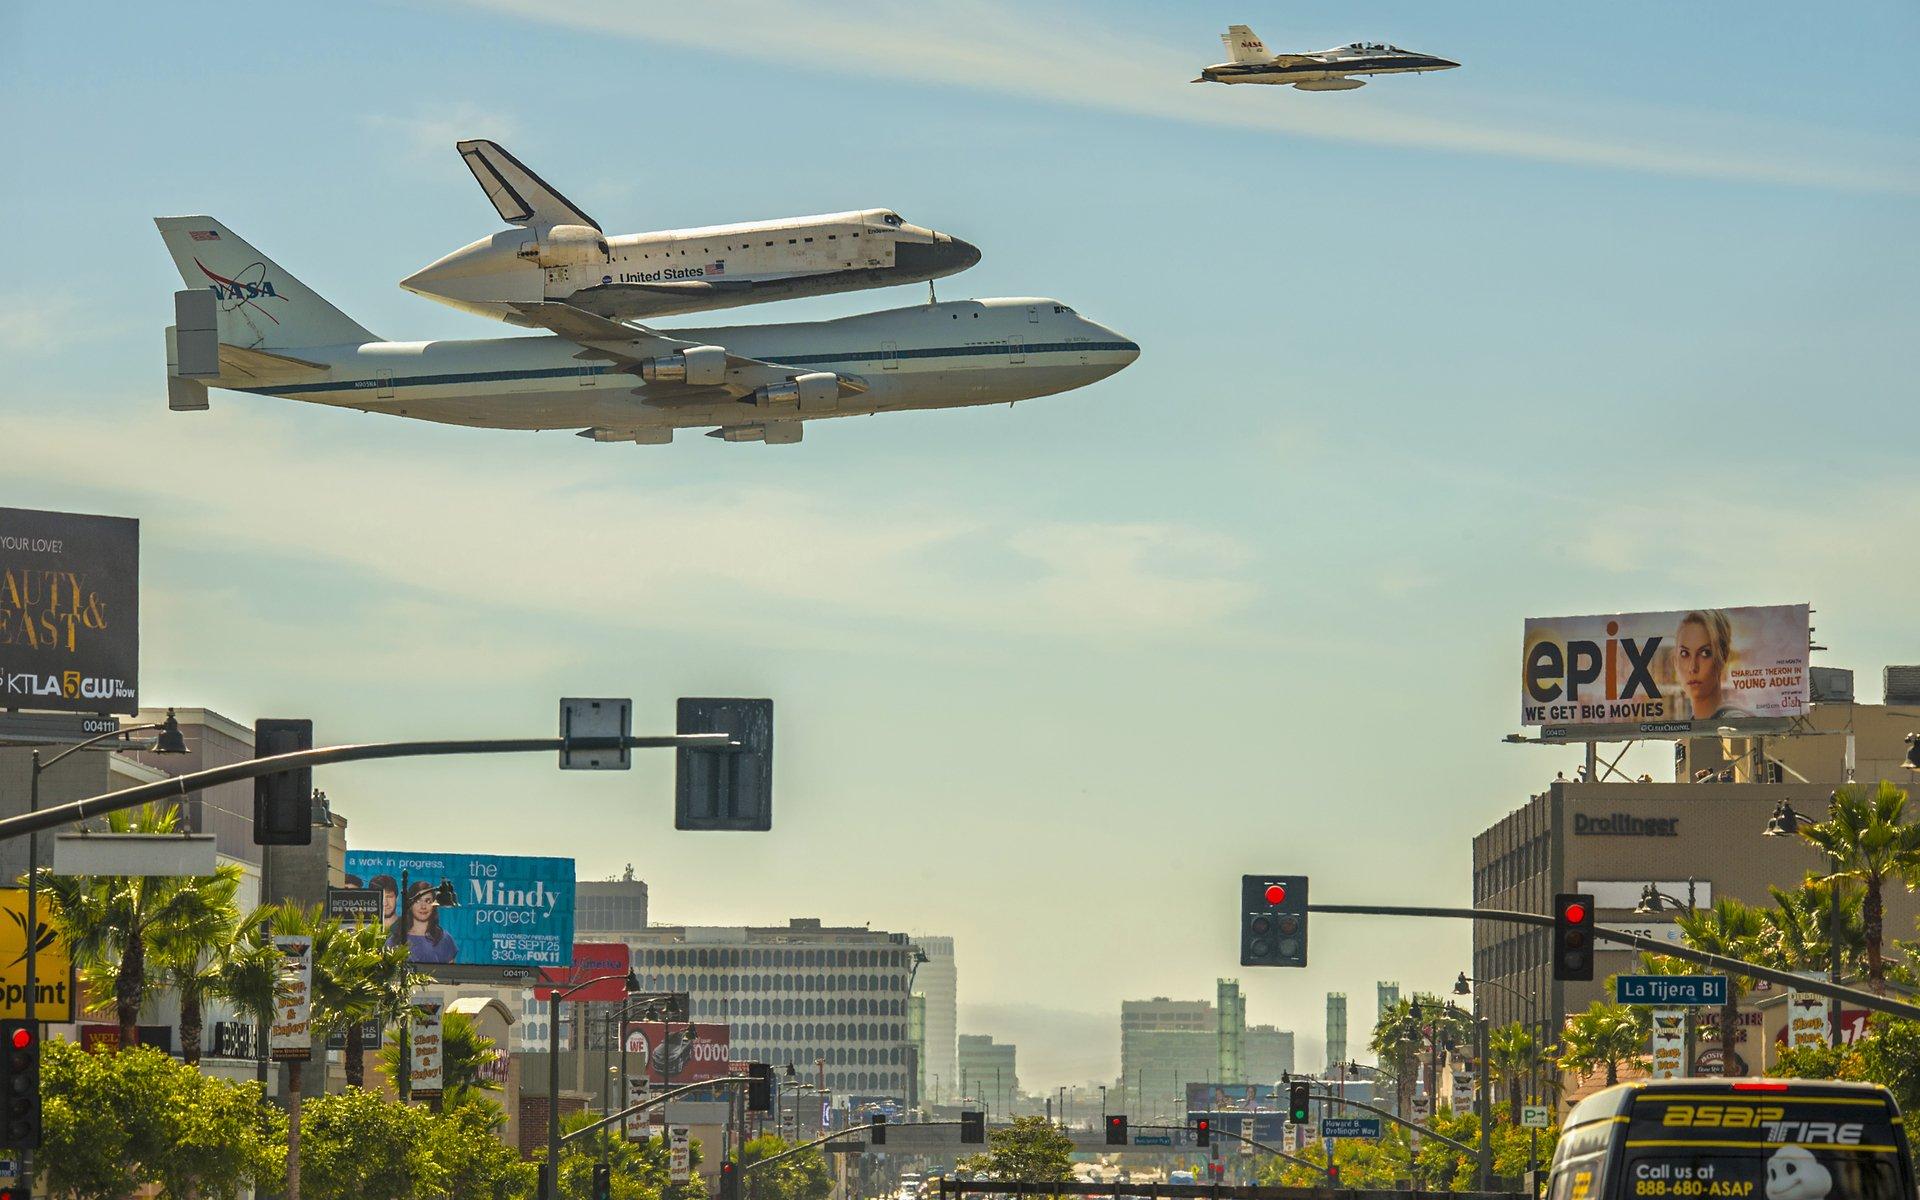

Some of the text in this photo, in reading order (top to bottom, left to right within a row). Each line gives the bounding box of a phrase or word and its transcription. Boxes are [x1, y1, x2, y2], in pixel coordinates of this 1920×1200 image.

[620, 267, 704, 283] United States
[209, 281, 278, 301] NASA
[0, 536, 63, 554] YOUR LOVE?
[1731, 666, 1802, 678] CHARLIZE THERON IN
[8, 673, 62, 696] KTLA
[65, 673, 78, 699] 5
[115, 679, 125, 688] TV
[1732, 676, 1802, 690] YOUNG ADULT
[115, 688, 136, 699] NOW
[1781, 696, 1801, 708] dish
[1525, 702, 1664, 721] WE GET BIG MOVIES
[83, 720, 116, 732] 004111
[349, 857, 356, 866] a
[359, 857, 383, 867] work
[386, 857, 396, 866] in
[469, 860, 498, 877] the
[468, 878, 561, 918] Mindy
[476, 907, 537, 927] project
[493, 939, 560, 952] TUE SEPT 25
[527, 951, 548, 962] FOX
[549, 951, 560, 962] 11
[1625, 981, 1719, 1001] La Tijera Bl
[1524, 1109, 1536, 1123] P
[1325, 1120, 1352, 1128] Howard
[1361, 1128, 1377, 1136] Way
[1761, 1121, 1865, 1145] TIRE
[1636, 1164, 1715, 1179] Call us at
[1636, 1180, 1754, 1197] 888-680-ASAP
